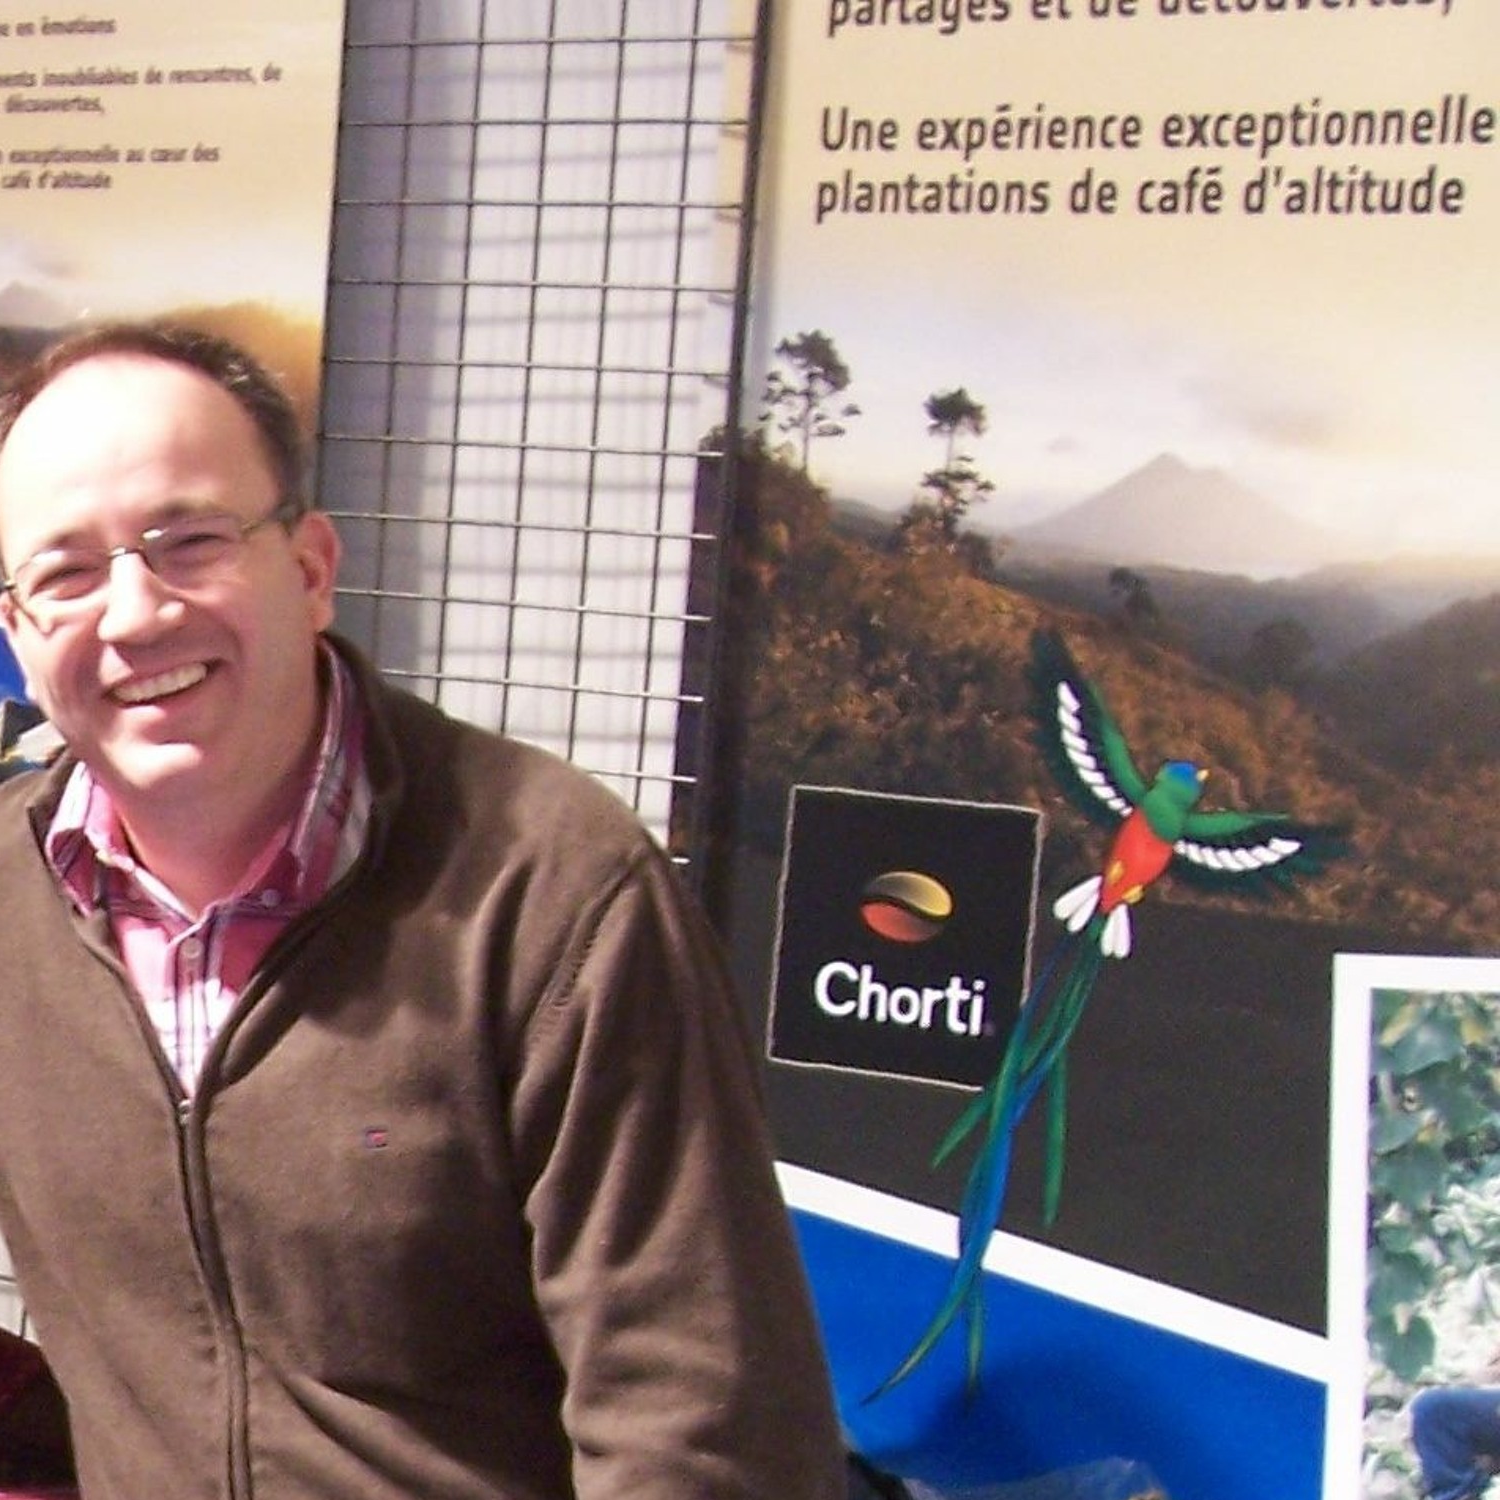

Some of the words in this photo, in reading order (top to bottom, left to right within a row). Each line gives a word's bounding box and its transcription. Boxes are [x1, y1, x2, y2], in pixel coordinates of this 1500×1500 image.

[821, 107, 898, 153] Une
[916, 104, 1142, 160] expérience
[1161, 93, 1496, 158] exceptionnelle
[816, 168, 1050, 224] plantations
[1068, 168, 1117, 215] de
[1136, 167, 1224, 215] café
[1243, 164, 1466, 215] d'altitude
[814, 961, 987, 1037] Chorti
